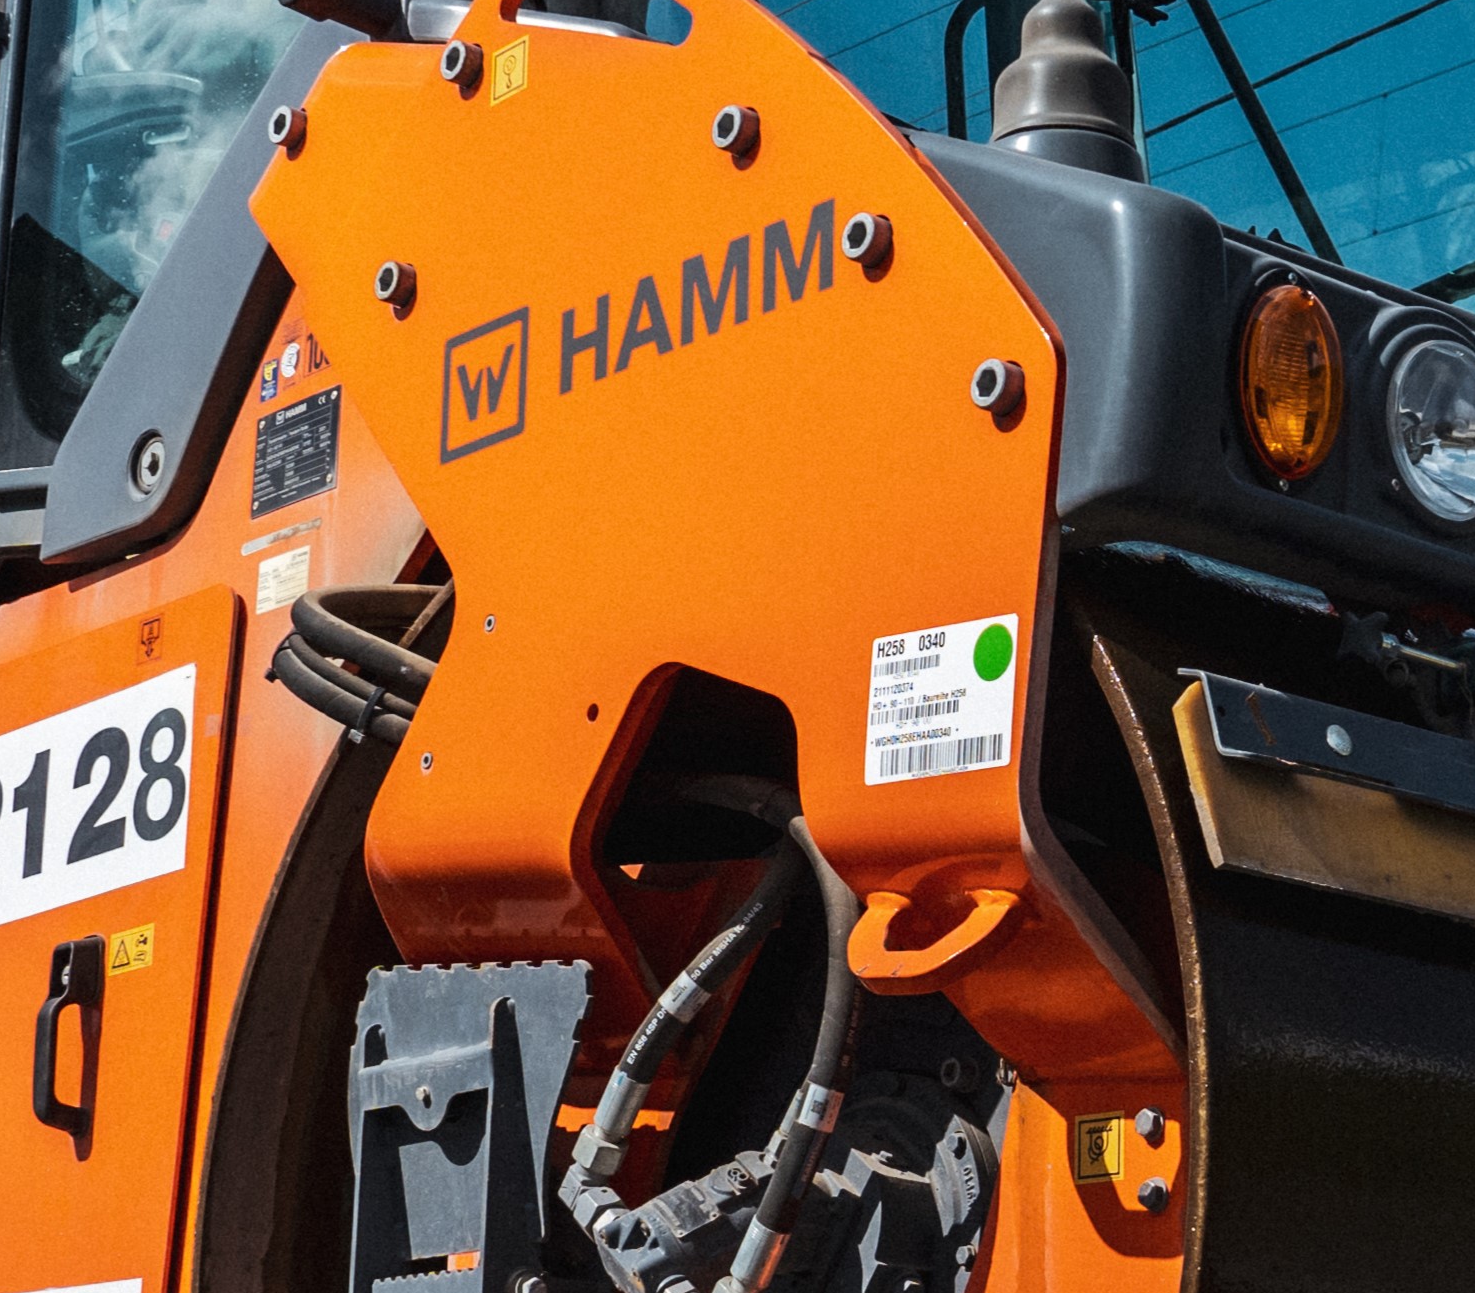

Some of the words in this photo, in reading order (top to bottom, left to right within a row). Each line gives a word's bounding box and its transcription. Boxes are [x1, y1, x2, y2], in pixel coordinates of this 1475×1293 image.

[559, 197, 836, 396] HAMM
[877, 639, 905, 658] H258
[919, 631, 946, 651] 0340
[627, 1050, 638, 1065] EN
[646, 1018, 658, 1036] 4SP
